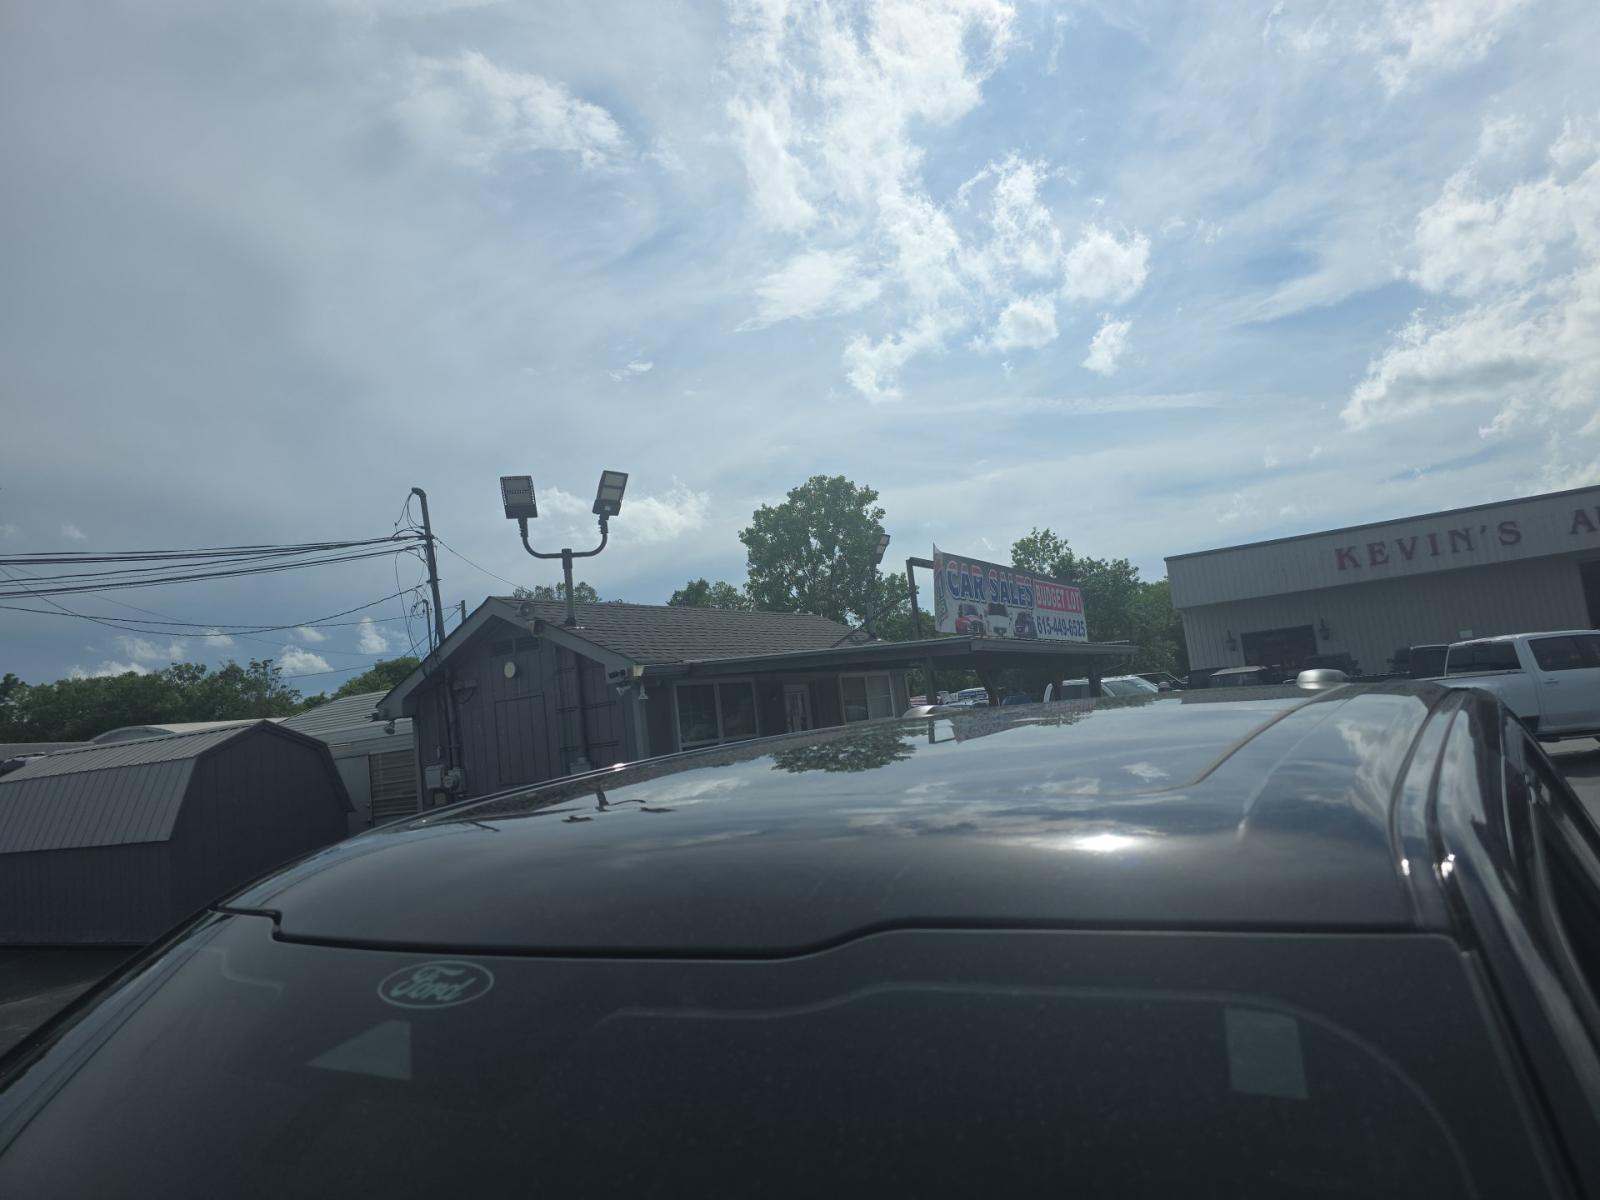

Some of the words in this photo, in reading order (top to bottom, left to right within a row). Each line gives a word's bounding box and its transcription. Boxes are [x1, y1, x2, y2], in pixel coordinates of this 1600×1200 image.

[1334, 520, 1522, 571] KEVIN'S
[1568, 506, 1600, 535] A
[946, 560, 987, 603] CAR
[988, 568, 1034, 609] SALES
[389, 965, 478, 1001] Ford
